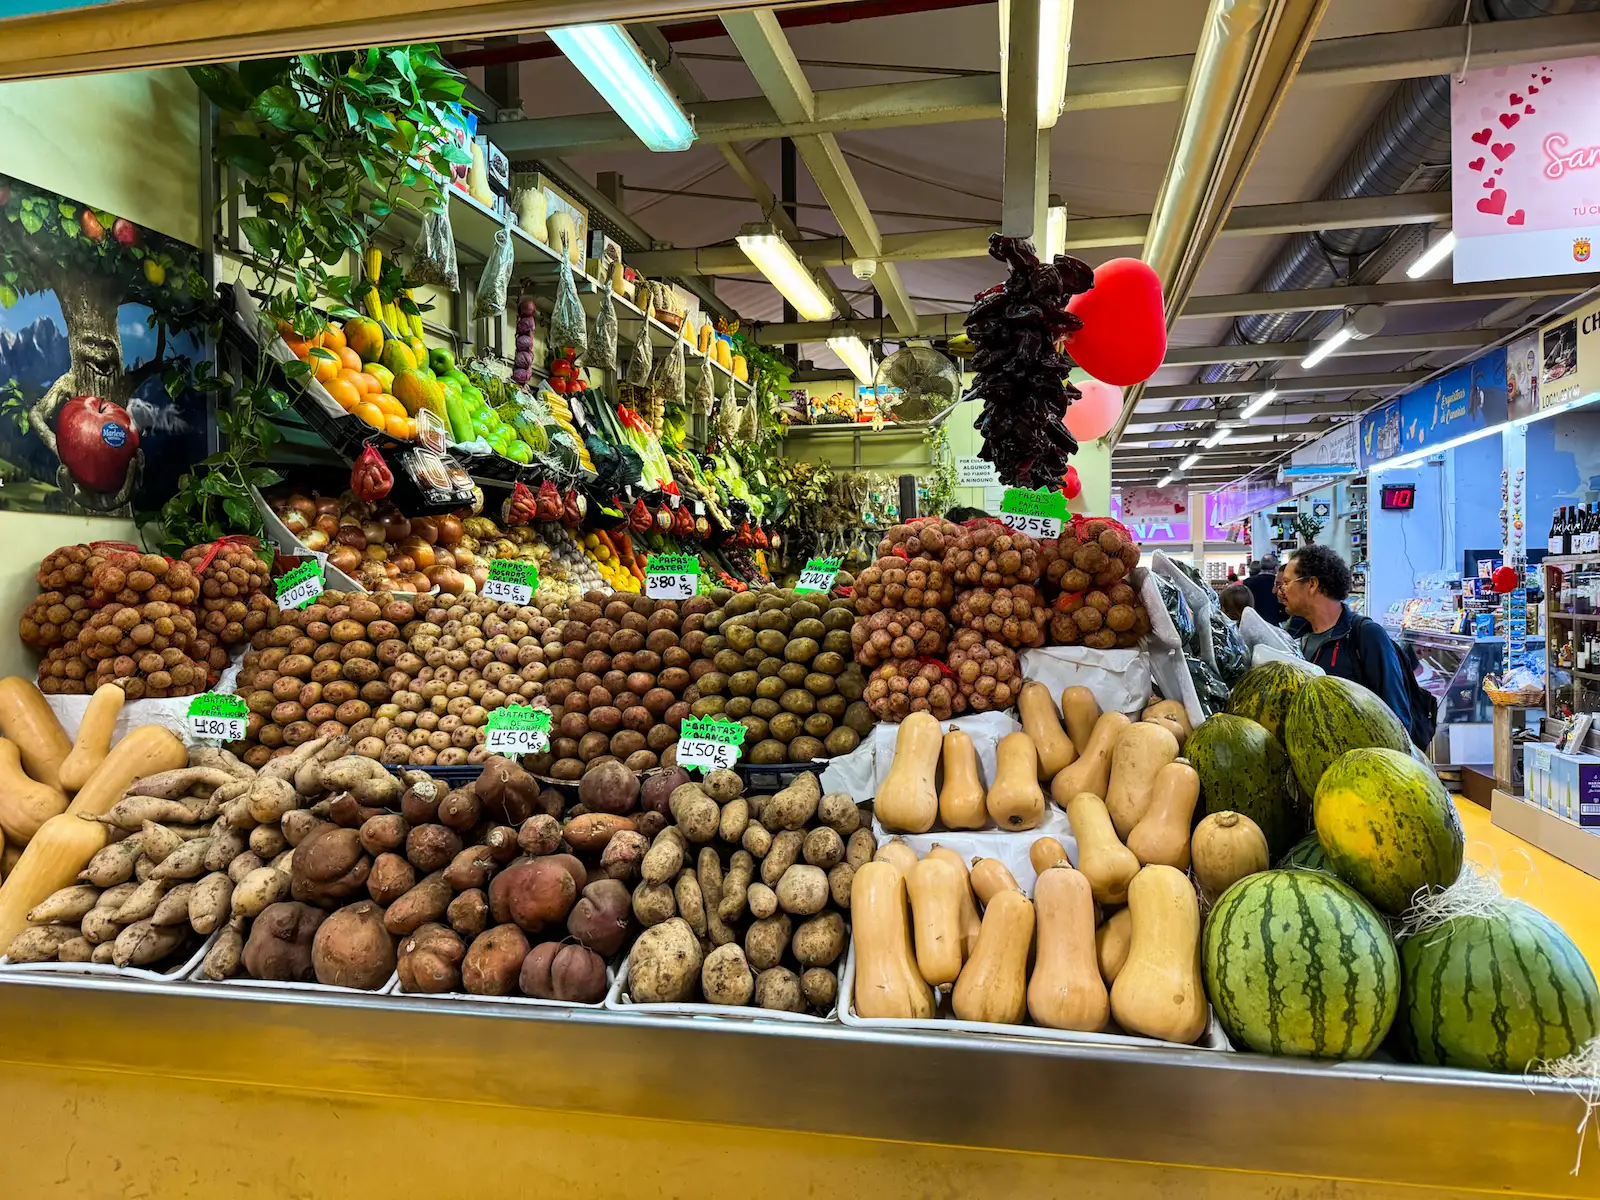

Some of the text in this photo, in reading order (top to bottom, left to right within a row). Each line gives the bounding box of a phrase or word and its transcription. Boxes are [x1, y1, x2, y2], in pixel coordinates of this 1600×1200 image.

[1572, 206, 1586, 216] TU
[1392, 490, 1411, 507] 10
[1019, 501, 1039, 510] PARA
